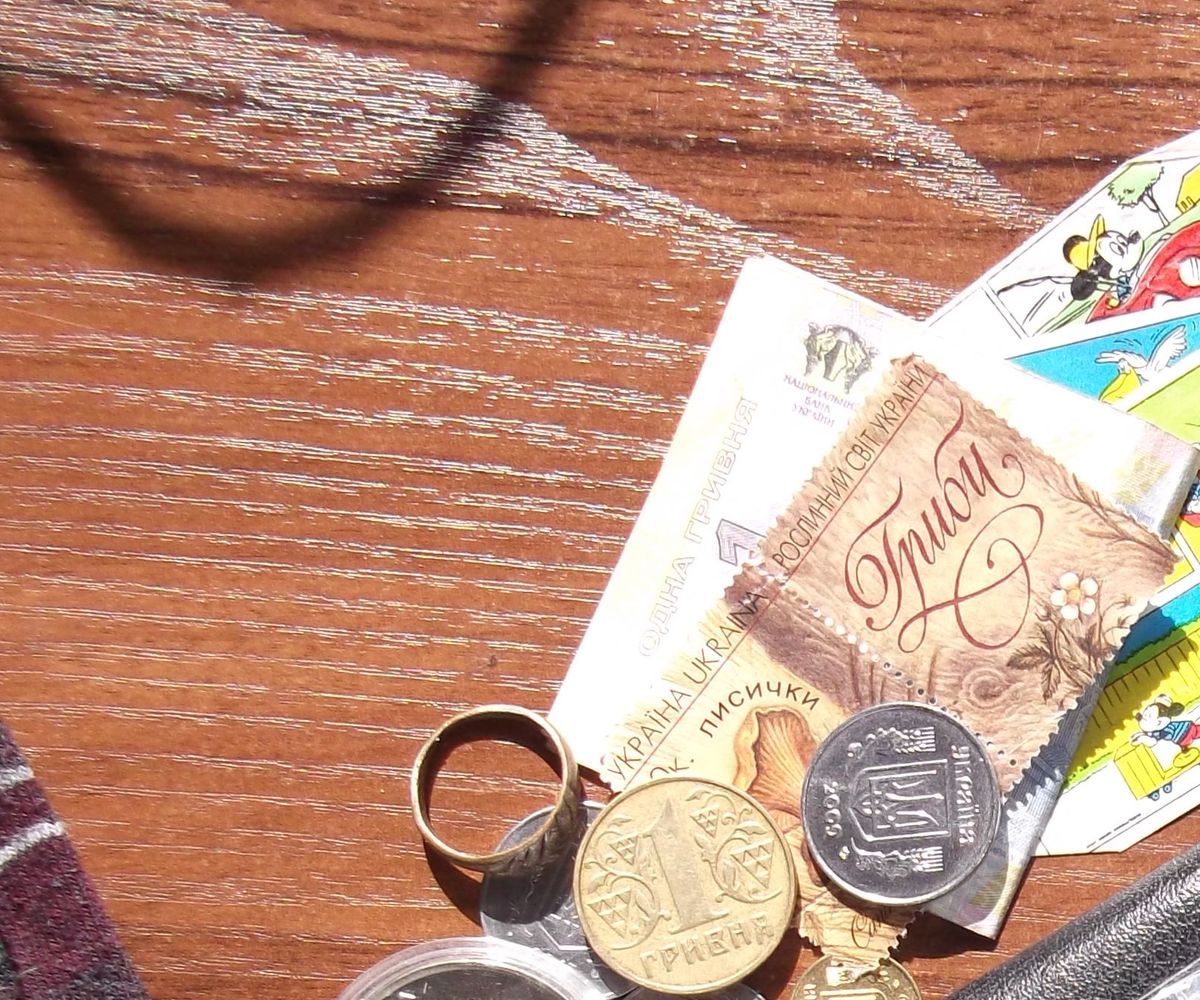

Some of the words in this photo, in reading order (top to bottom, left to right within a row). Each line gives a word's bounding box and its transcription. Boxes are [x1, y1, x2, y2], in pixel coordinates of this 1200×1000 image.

[638, 555, 694, 656] ОДНА
[684, 396, 759, 544] ГРИВНЯ
[772, 466, 854, 569] РОСЛИННИЙ
[845, 428, 881, 471] СВІТ
[870, 363, 929, 434] УКРАЇНИ
[607, 688, 692, 780] УКРАЇНА
[683, 591, 768, 684] UKRAINA
[700, 681, 820, 738] ЛИСИЧКИ
[639, 912, 775, 978] ГРИВНЯ
[648, 799, 729, 935] 1
